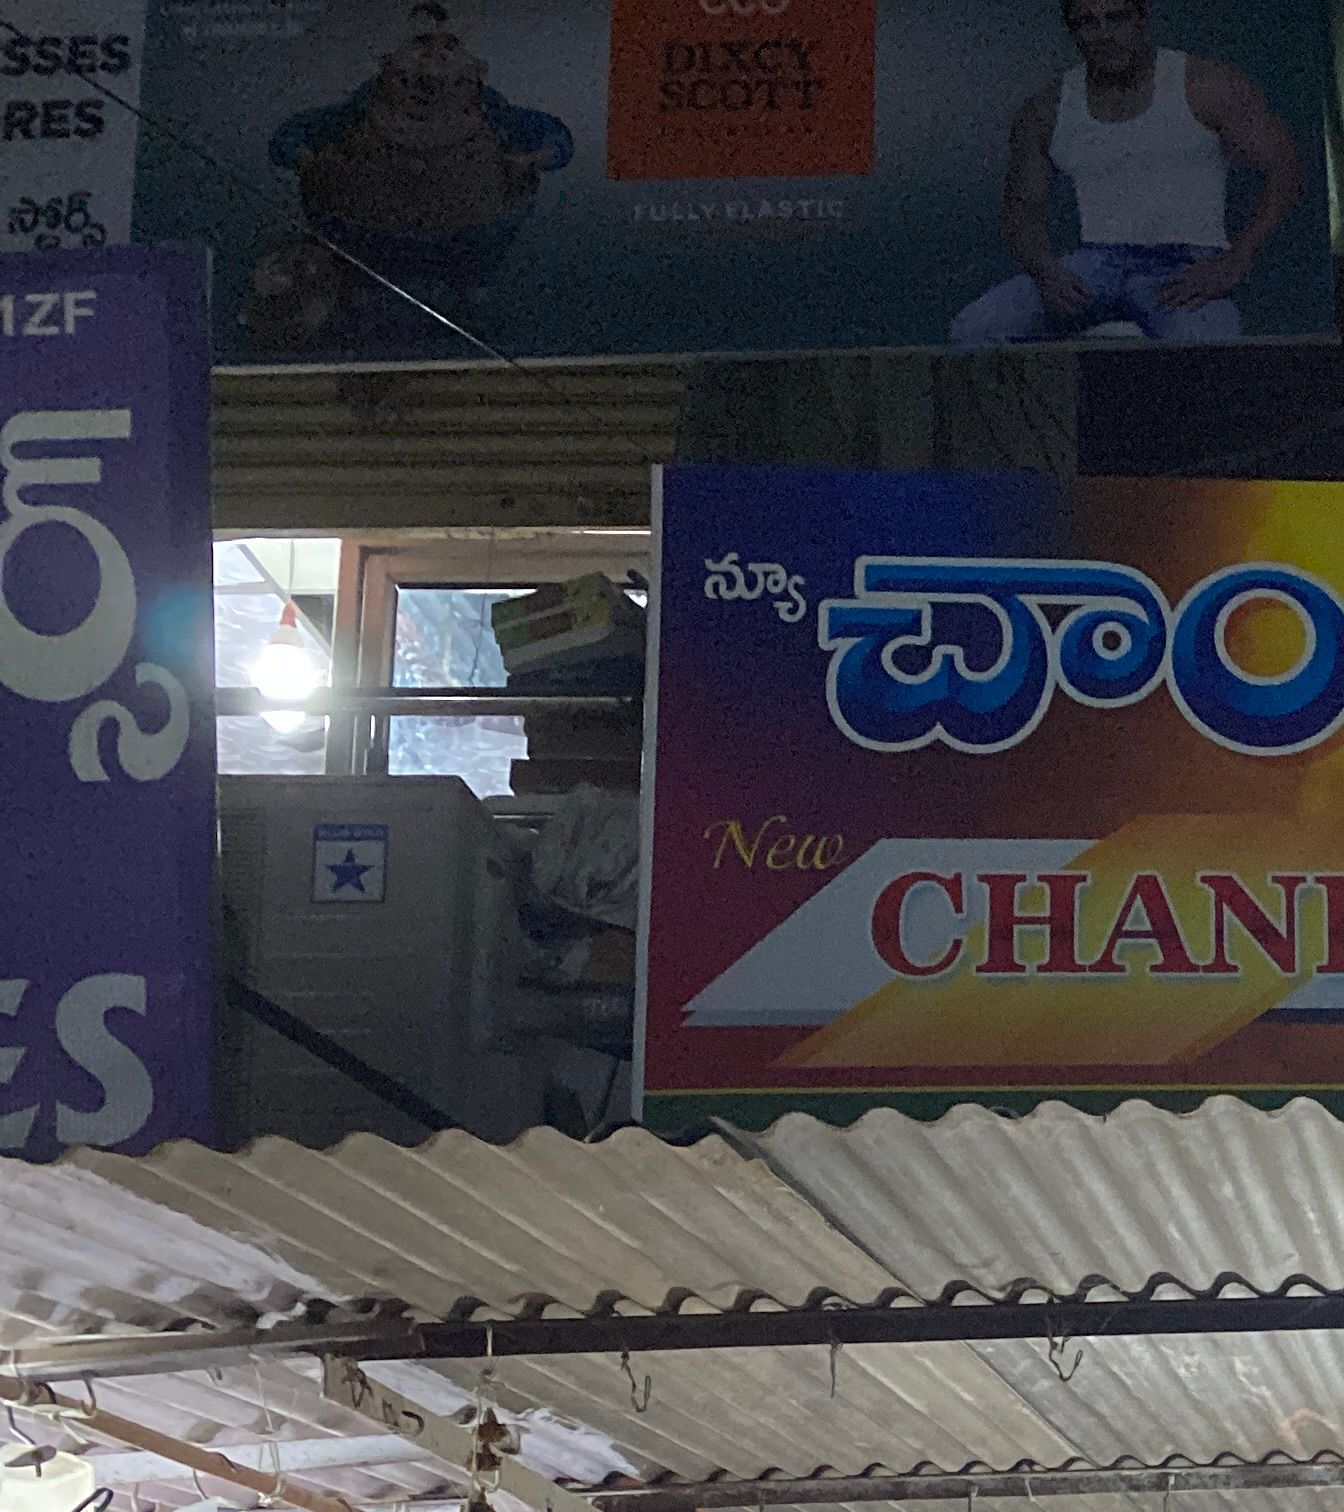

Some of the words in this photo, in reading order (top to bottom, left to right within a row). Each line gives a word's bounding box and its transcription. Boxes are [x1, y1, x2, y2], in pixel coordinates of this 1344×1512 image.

[663, 38, 819, 74] DIXCY
[659, 77, 824, 112] SCOTT
[633, 202, 717, 222] FULLY
[724, 198, 845, 221] ELASTIC
[704, 551, 808, 624] న్యూ
[704, 815, 847, 872] New
